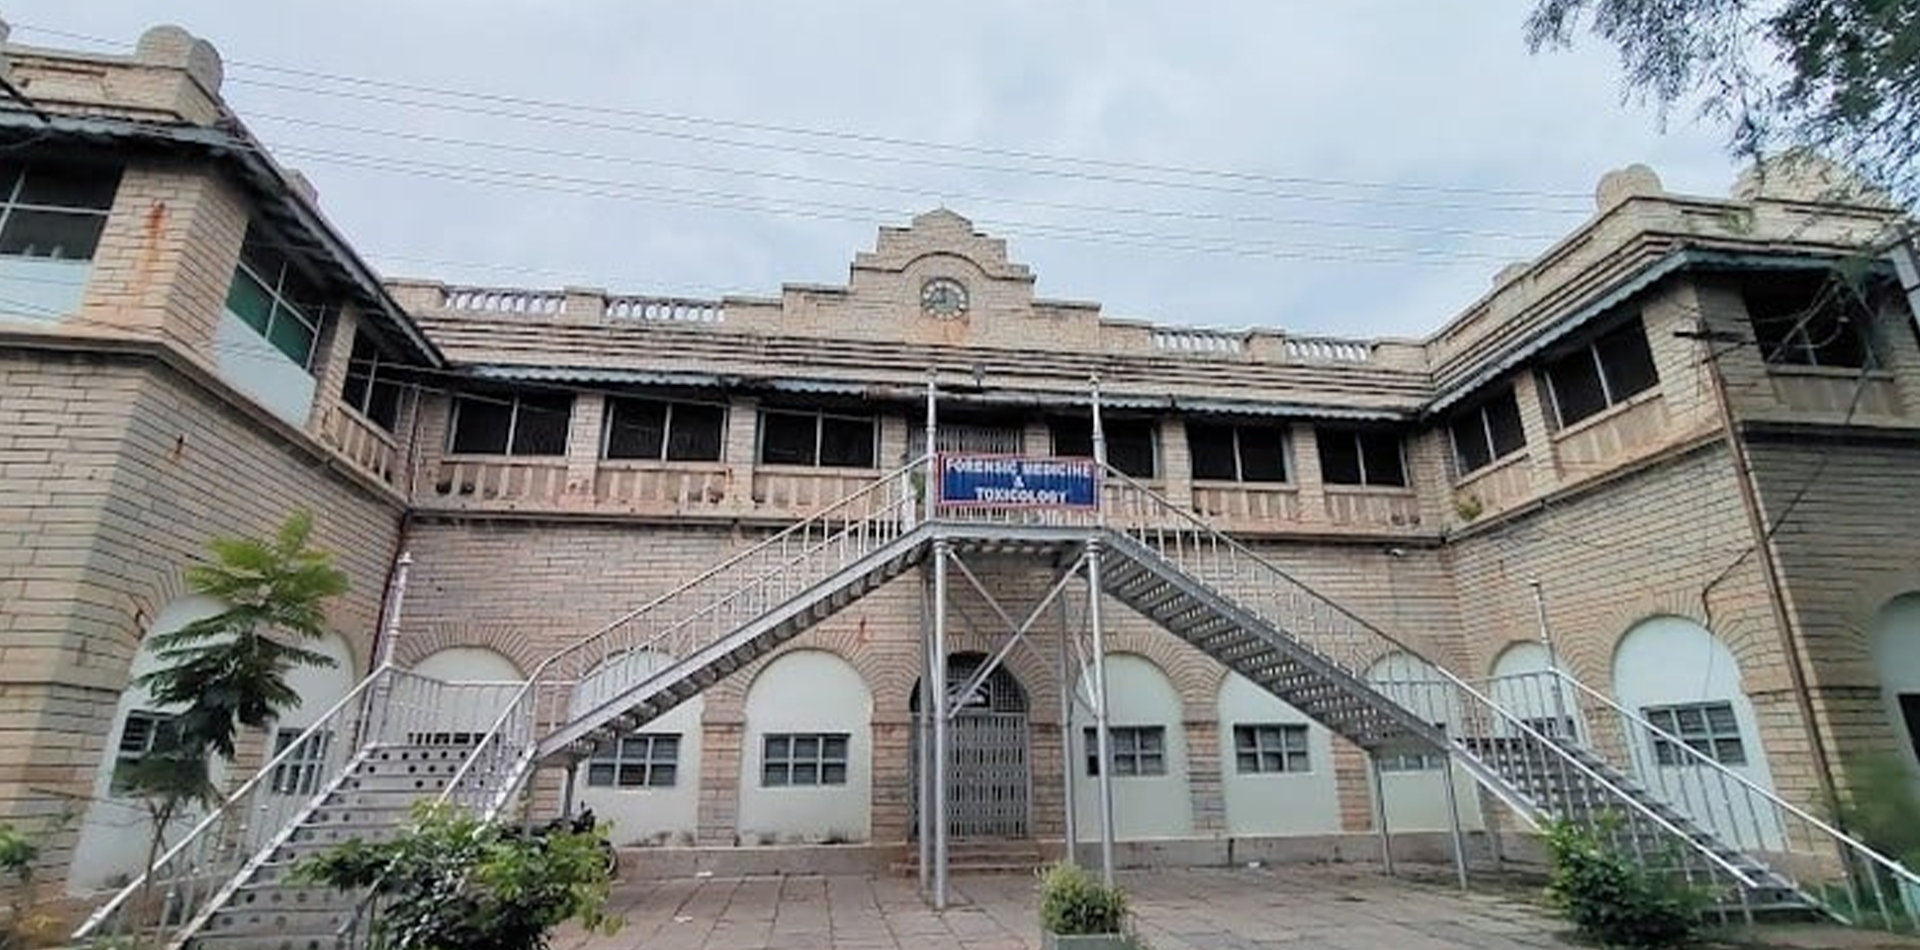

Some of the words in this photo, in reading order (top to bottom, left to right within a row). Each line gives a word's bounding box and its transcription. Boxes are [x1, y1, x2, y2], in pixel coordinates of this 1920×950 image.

[946, 459, 1018, 474] FORENSIC
[1022, 462, 1091, 477] MEDICINE
[1013, 476, 1024, 488] &
[975, 487, 1067, 502] TOXICOLOGY
